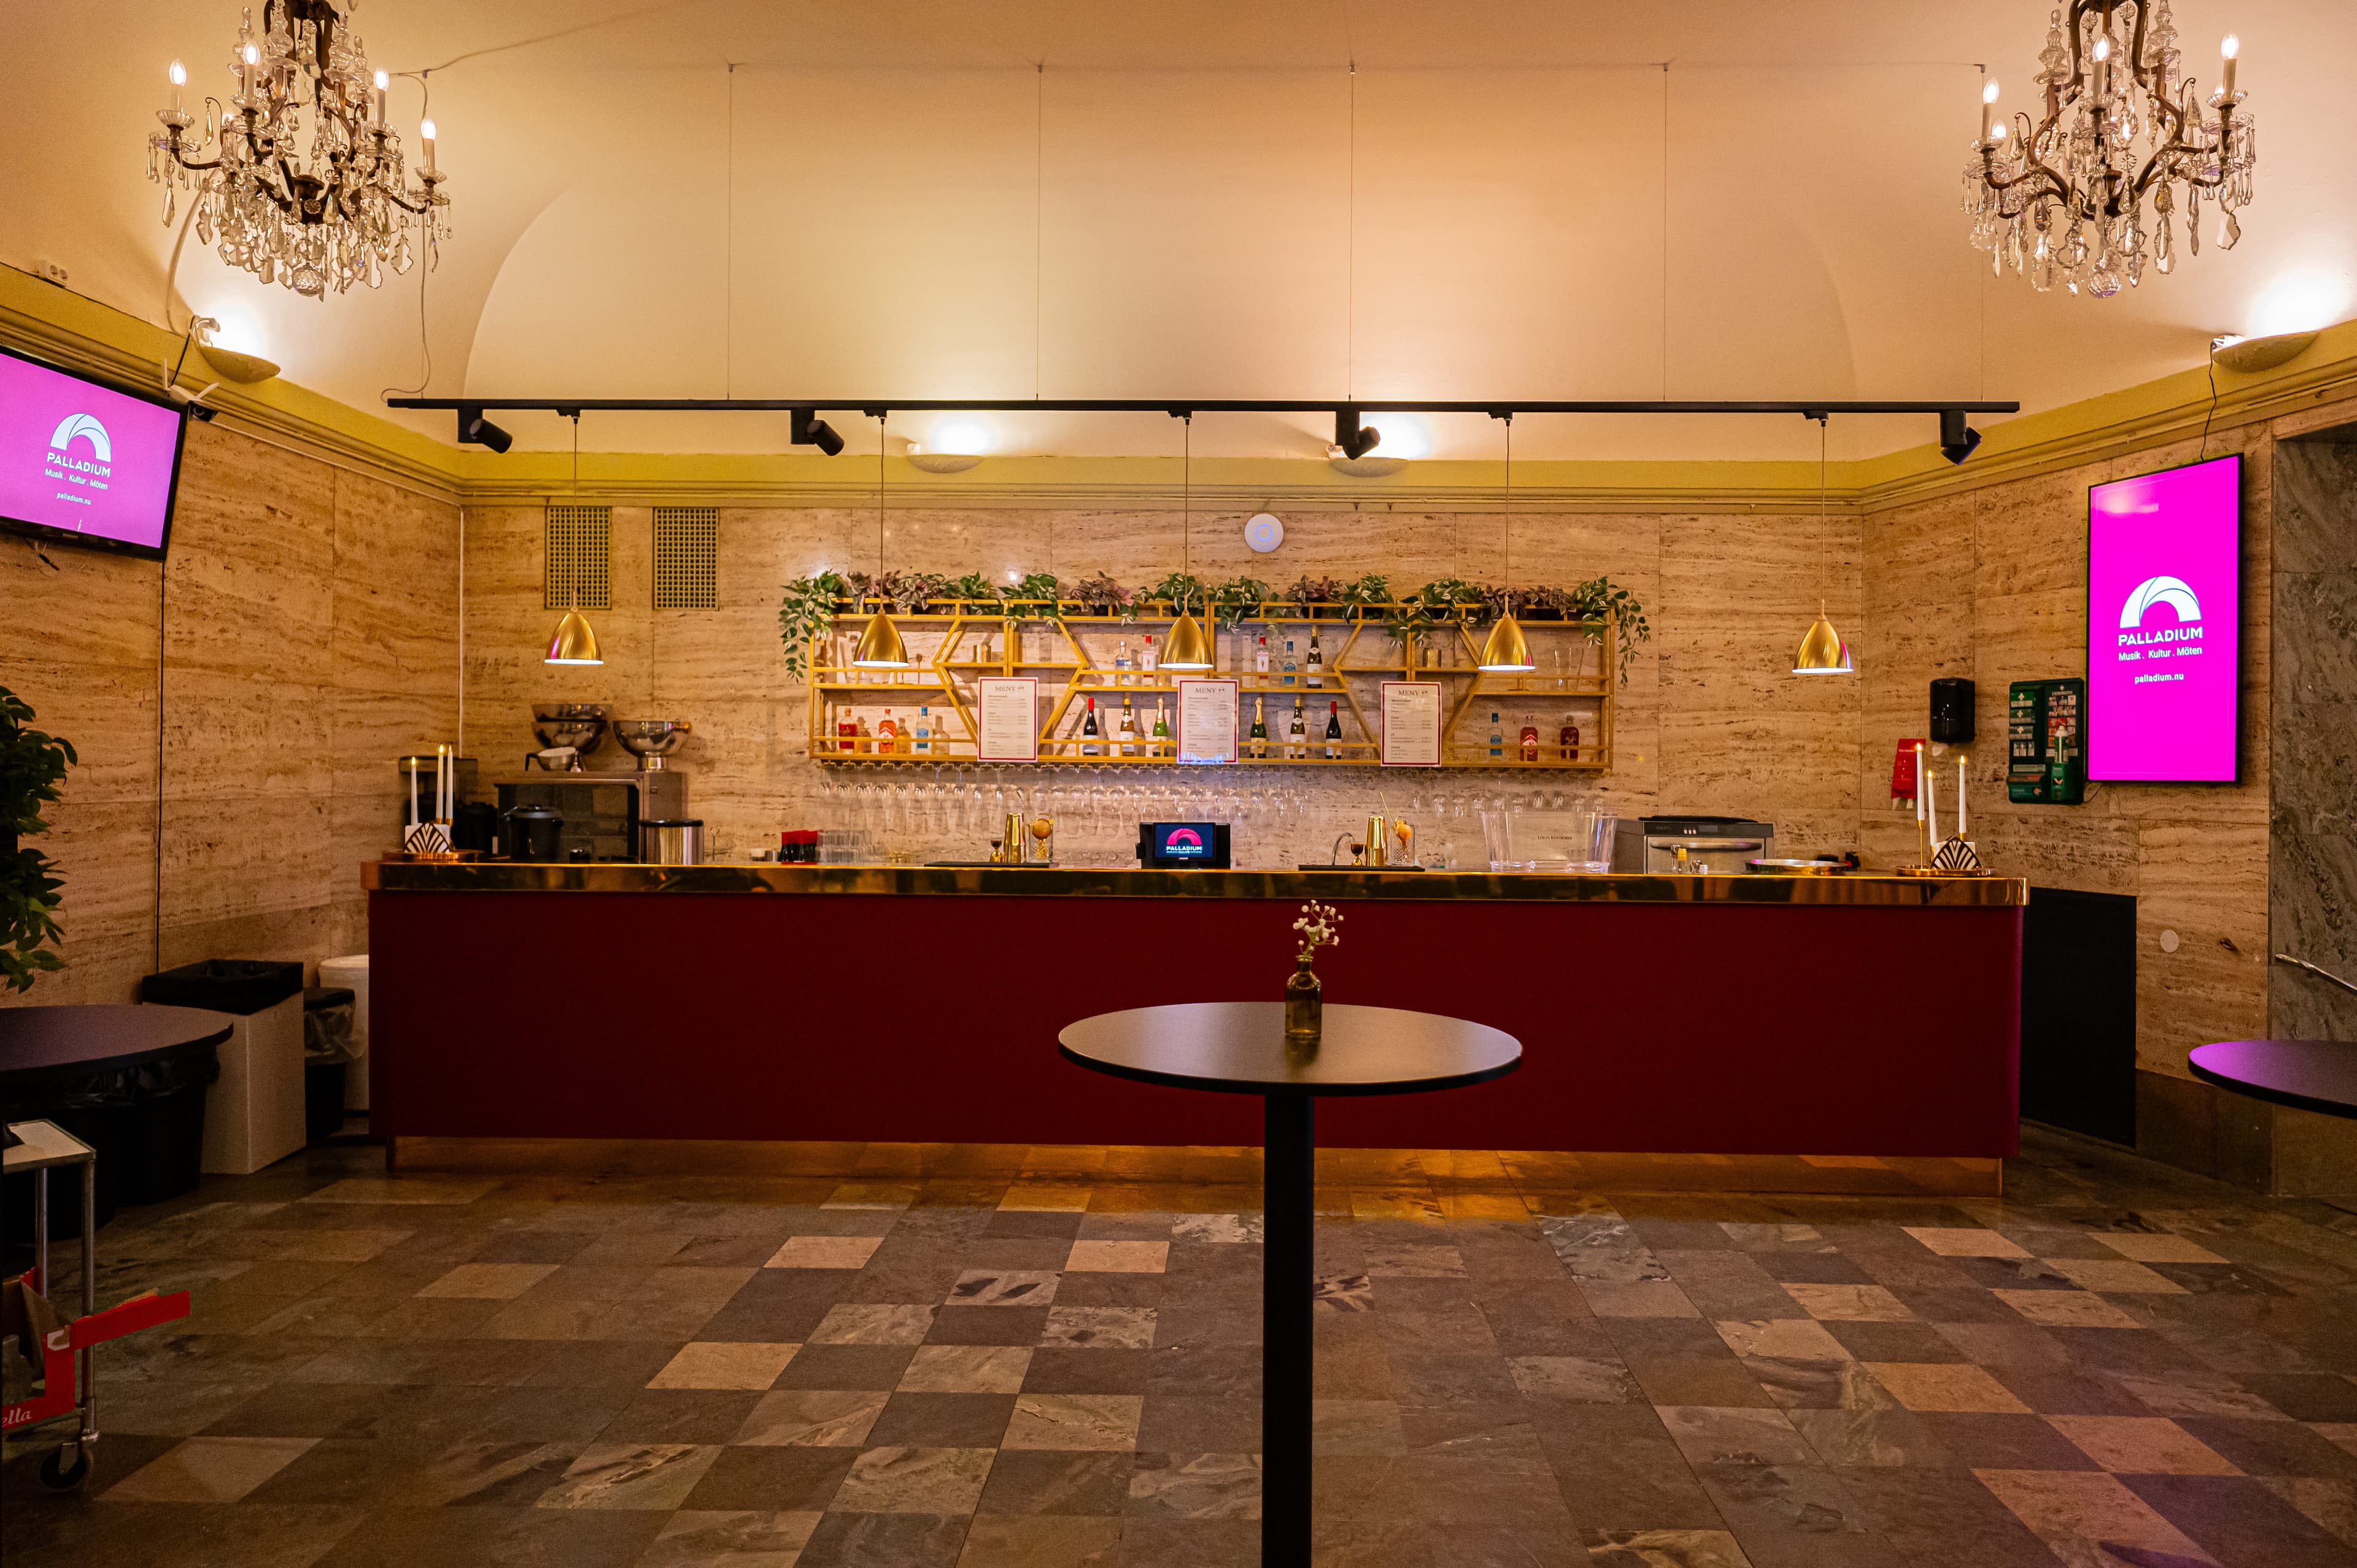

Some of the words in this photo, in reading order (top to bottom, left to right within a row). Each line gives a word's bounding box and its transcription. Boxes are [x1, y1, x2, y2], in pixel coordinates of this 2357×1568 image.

[47, 452, 111, 478] PALLADIUM
[56, 492, 91, 505] palladium.nu
[2118, 626, 2203, 646] PALLADIUM
[2177, 646, 2202, 656] Möten
[2135, 673, 2184, 685] palladium.nu
